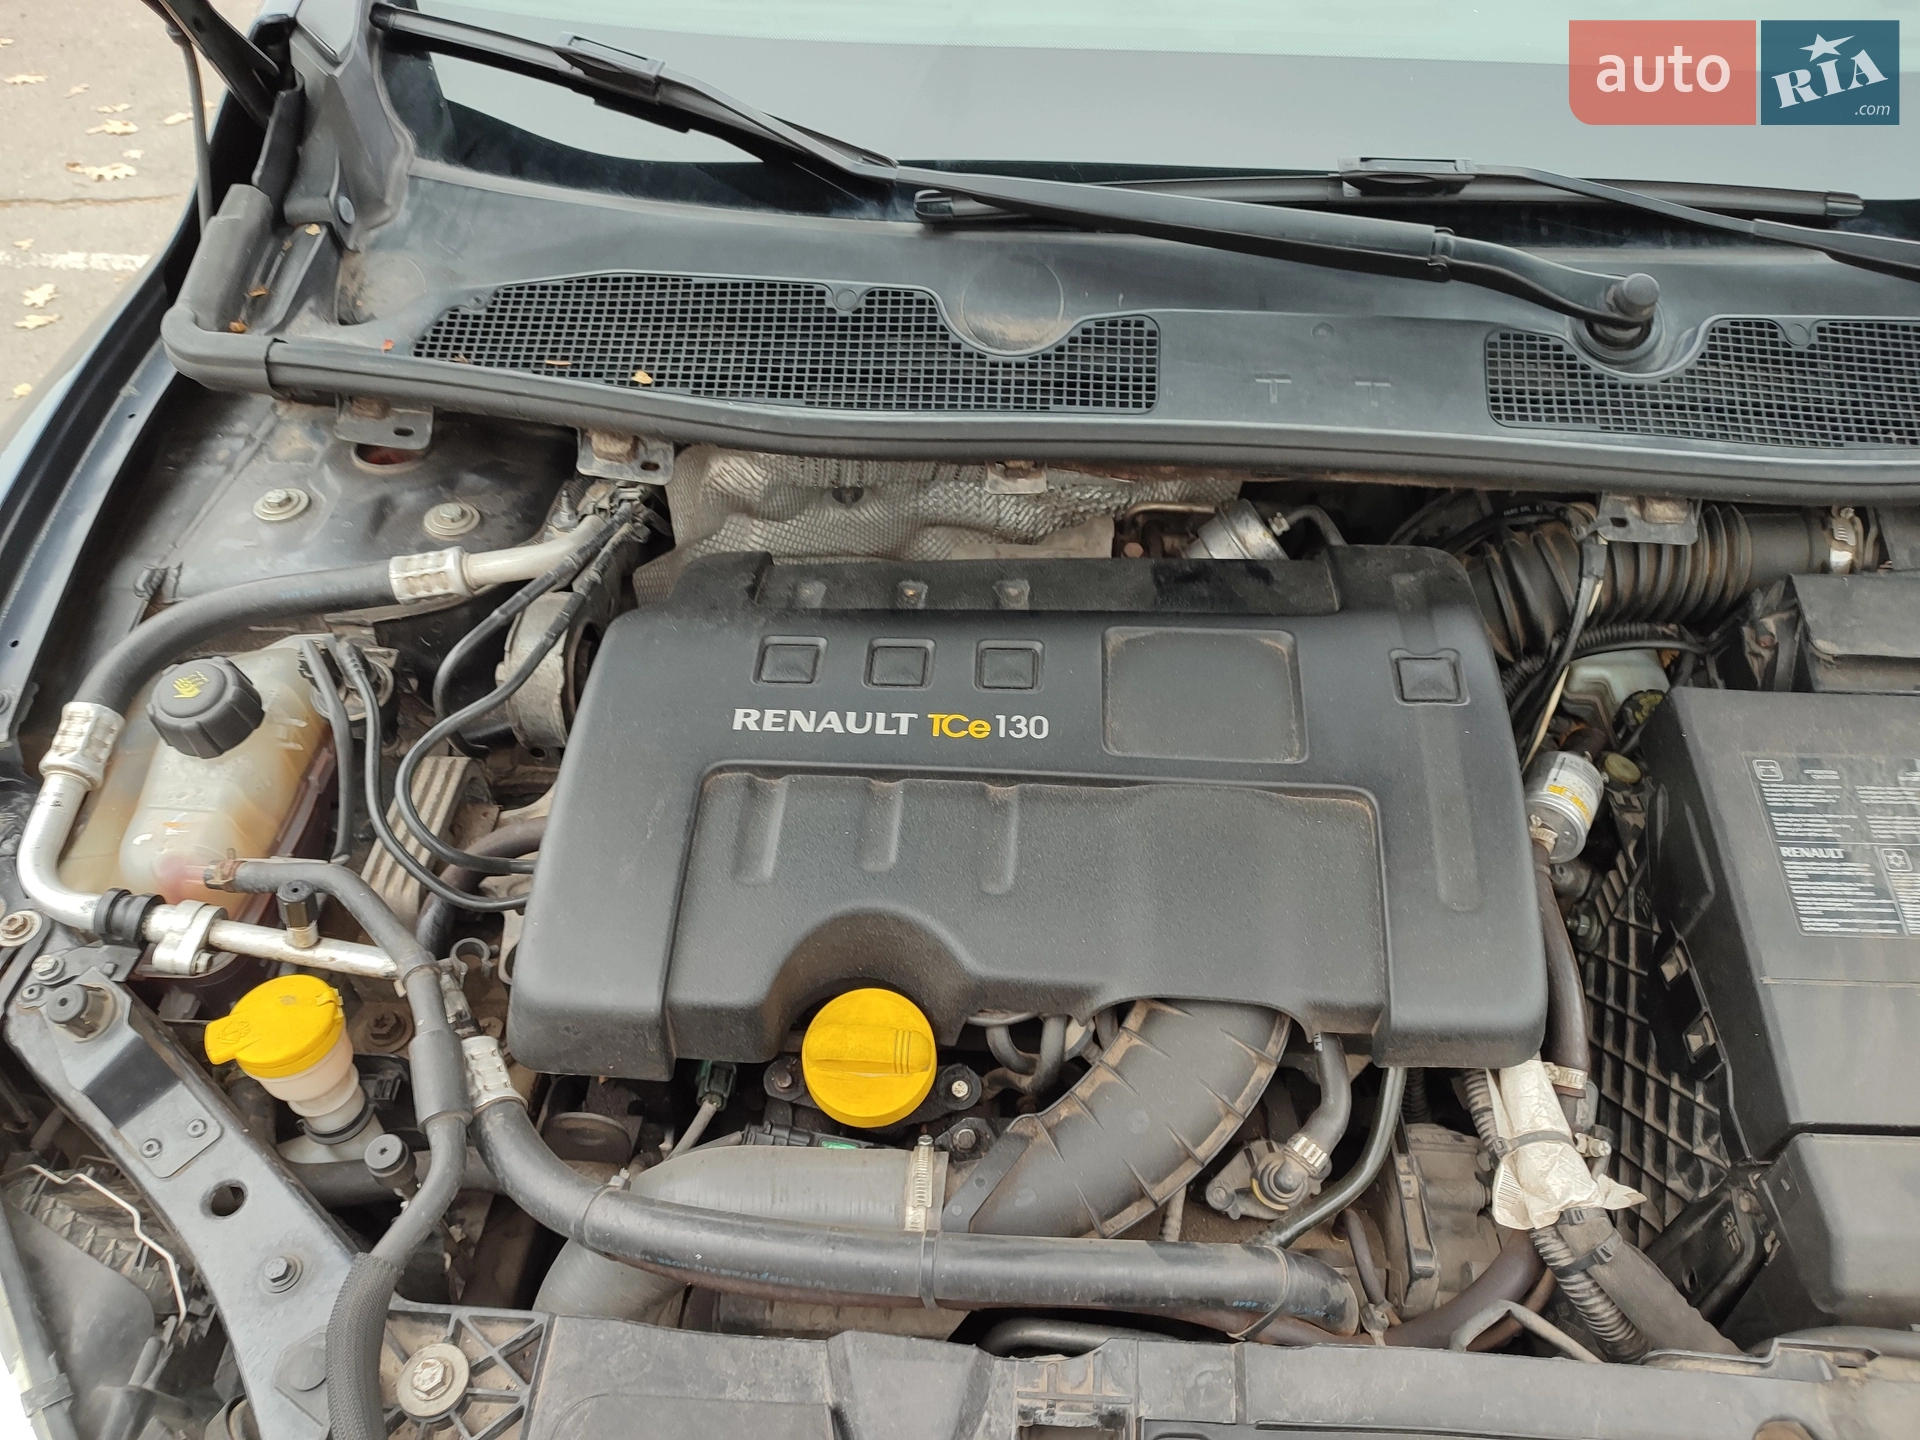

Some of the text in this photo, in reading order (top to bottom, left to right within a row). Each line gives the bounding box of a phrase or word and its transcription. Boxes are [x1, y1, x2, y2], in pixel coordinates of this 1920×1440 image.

[732, 708, 1049, 740] RENAULT TCe 130
[1779, 846, 1845, 859] RENAULT
